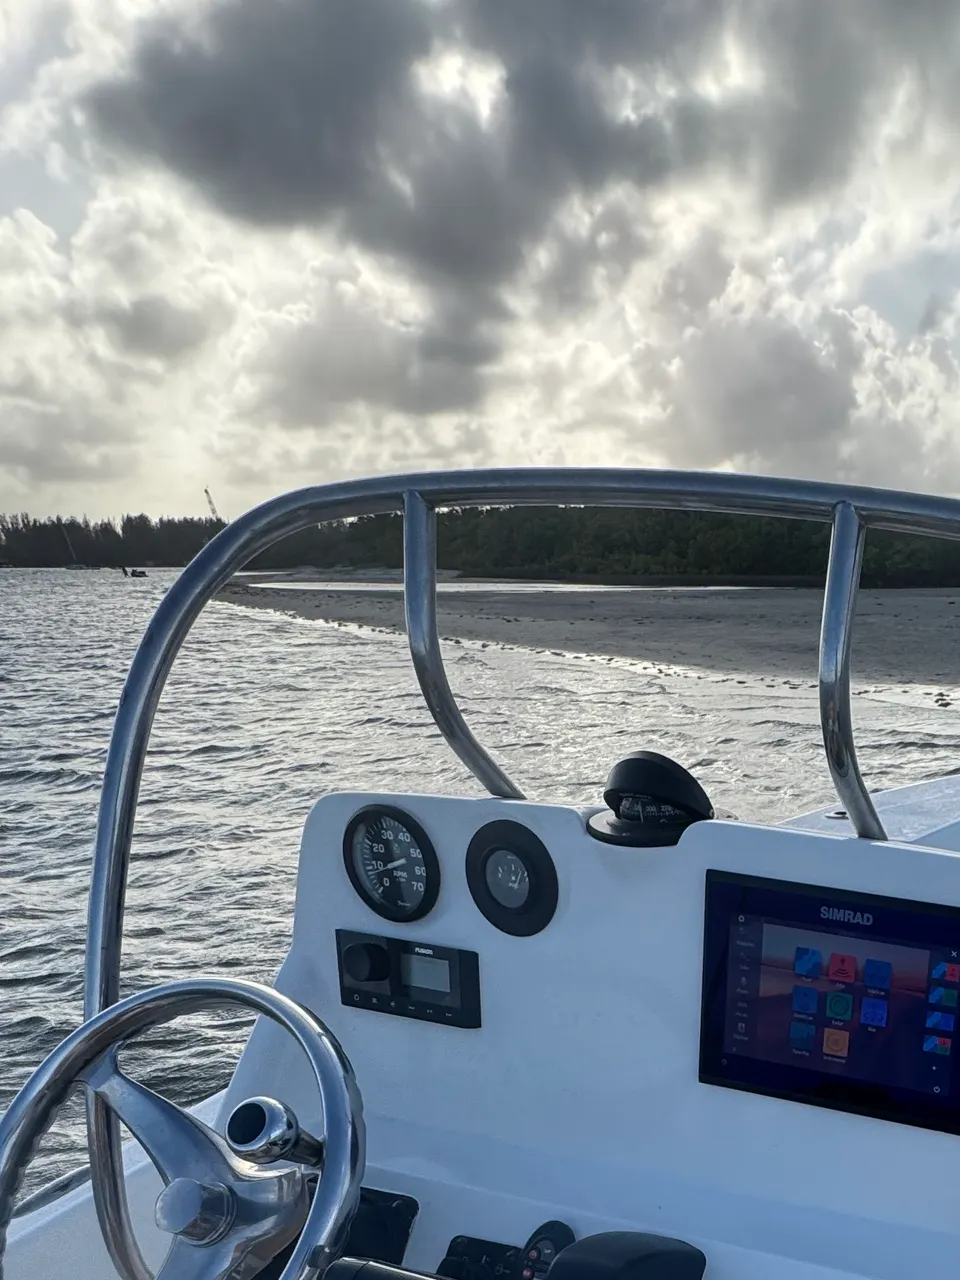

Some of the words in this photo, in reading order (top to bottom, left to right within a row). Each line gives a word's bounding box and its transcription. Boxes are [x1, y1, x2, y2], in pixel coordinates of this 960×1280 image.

[381, 830, 394, 840] 30
[398, 832, 411, 842] 40
[372, 843, 385, 853] 20
[410, 848, 423, 858] 50
[372, 860, 384, 869] 10
[414, 866, 426, 876] 60
[383, 877, 390, 887] 0
[411, 881, 425, 891] 70
[820, 905, 874, 926] SIMRAD
